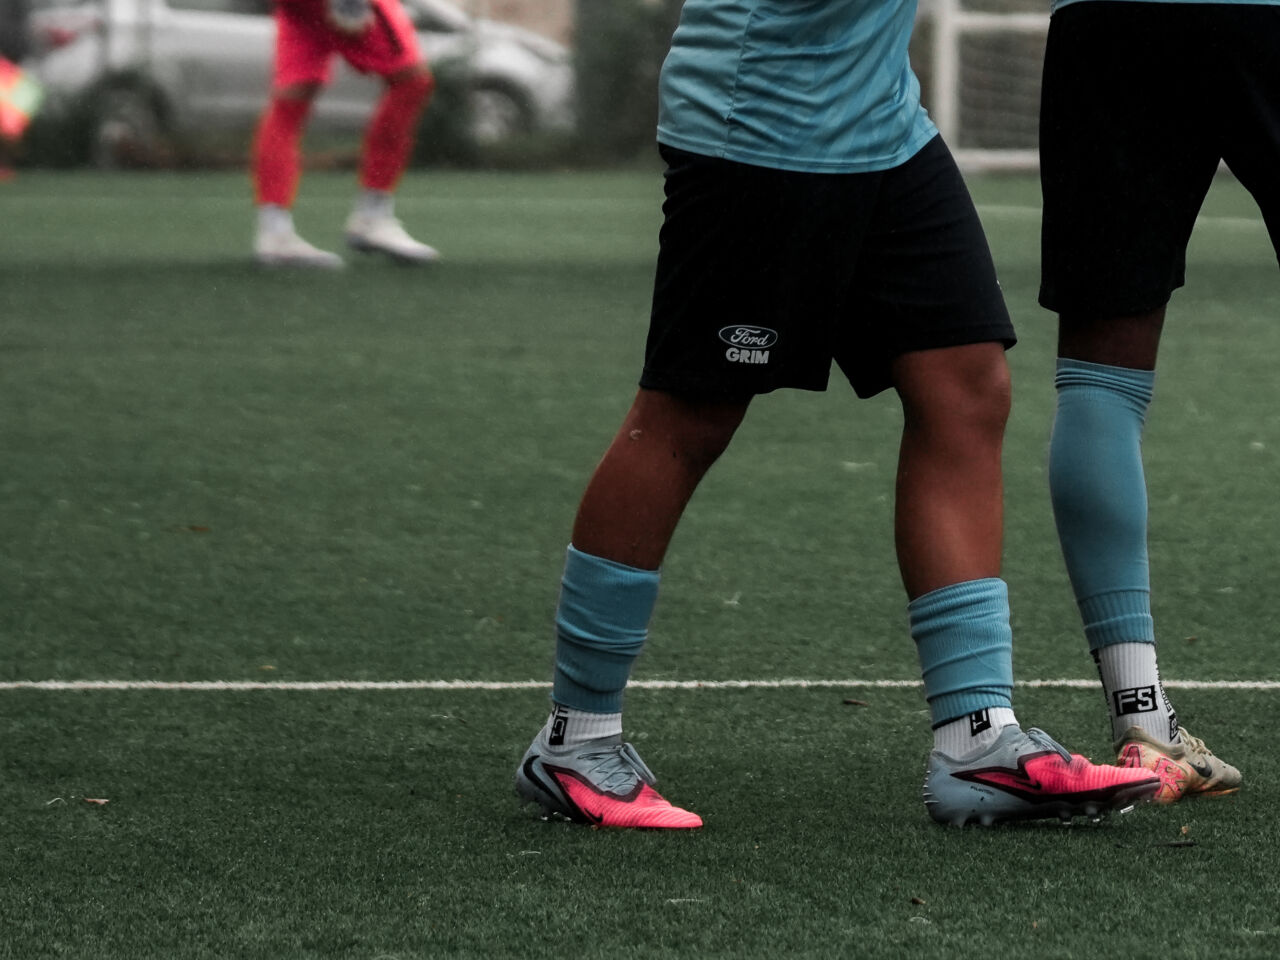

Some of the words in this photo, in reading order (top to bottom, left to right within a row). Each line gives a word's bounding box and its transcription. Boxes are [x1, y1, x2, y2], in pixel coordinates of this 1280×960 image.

[730, 327, 770, 346] Ford
[725, 347, 770, 364] GRIM
[1117, 688, 1154, 714] FS
